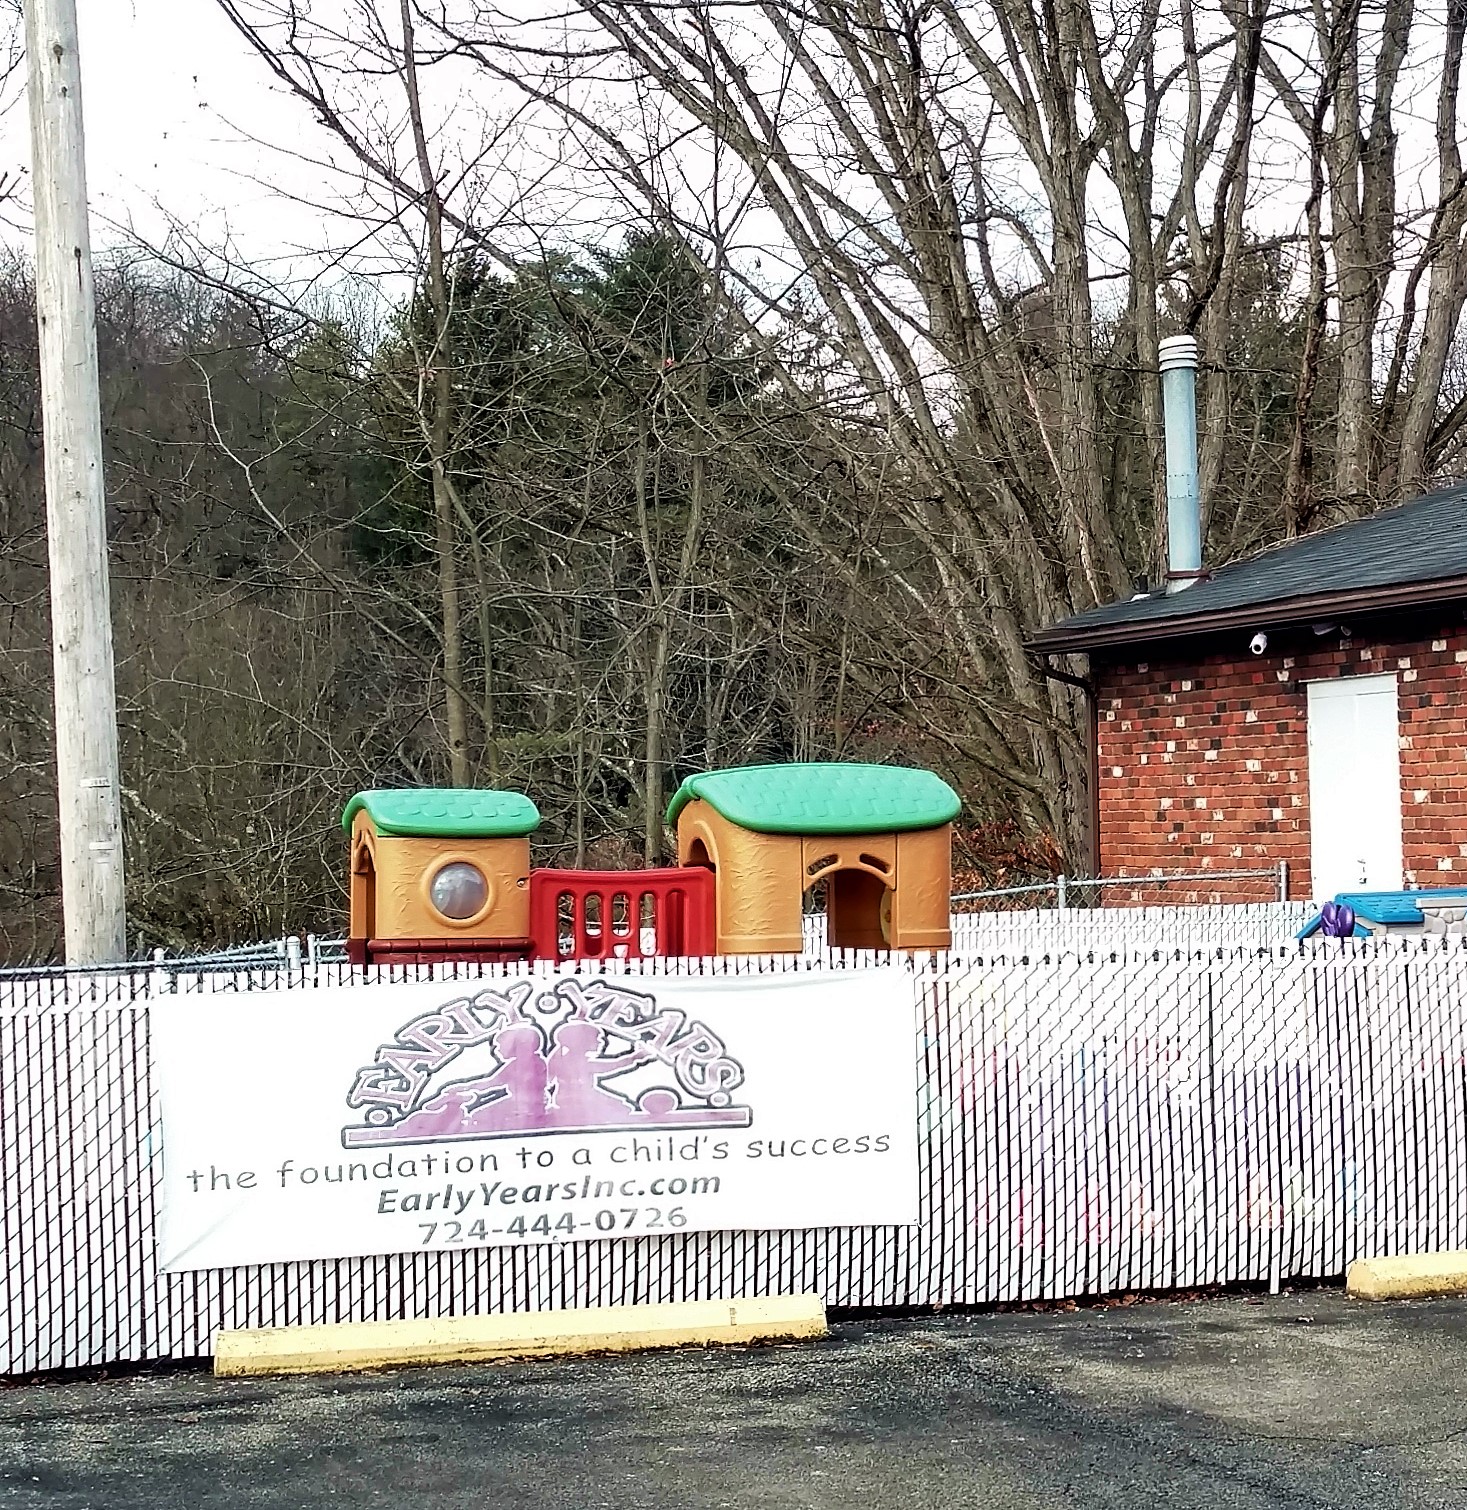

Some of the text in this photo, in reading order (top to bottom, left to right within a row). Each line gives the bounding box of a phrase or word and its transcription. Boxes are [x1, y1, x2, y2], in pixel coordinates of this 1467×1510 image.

[347, 978, 745, 1109] EARLY YEARS
[187, 1133, 891, 1193] the foundation to a child's success
[377, 1174, 721, 1216] EarlyYearsInc.com
[418, 1206, 688, 1246] 724-444-0726
